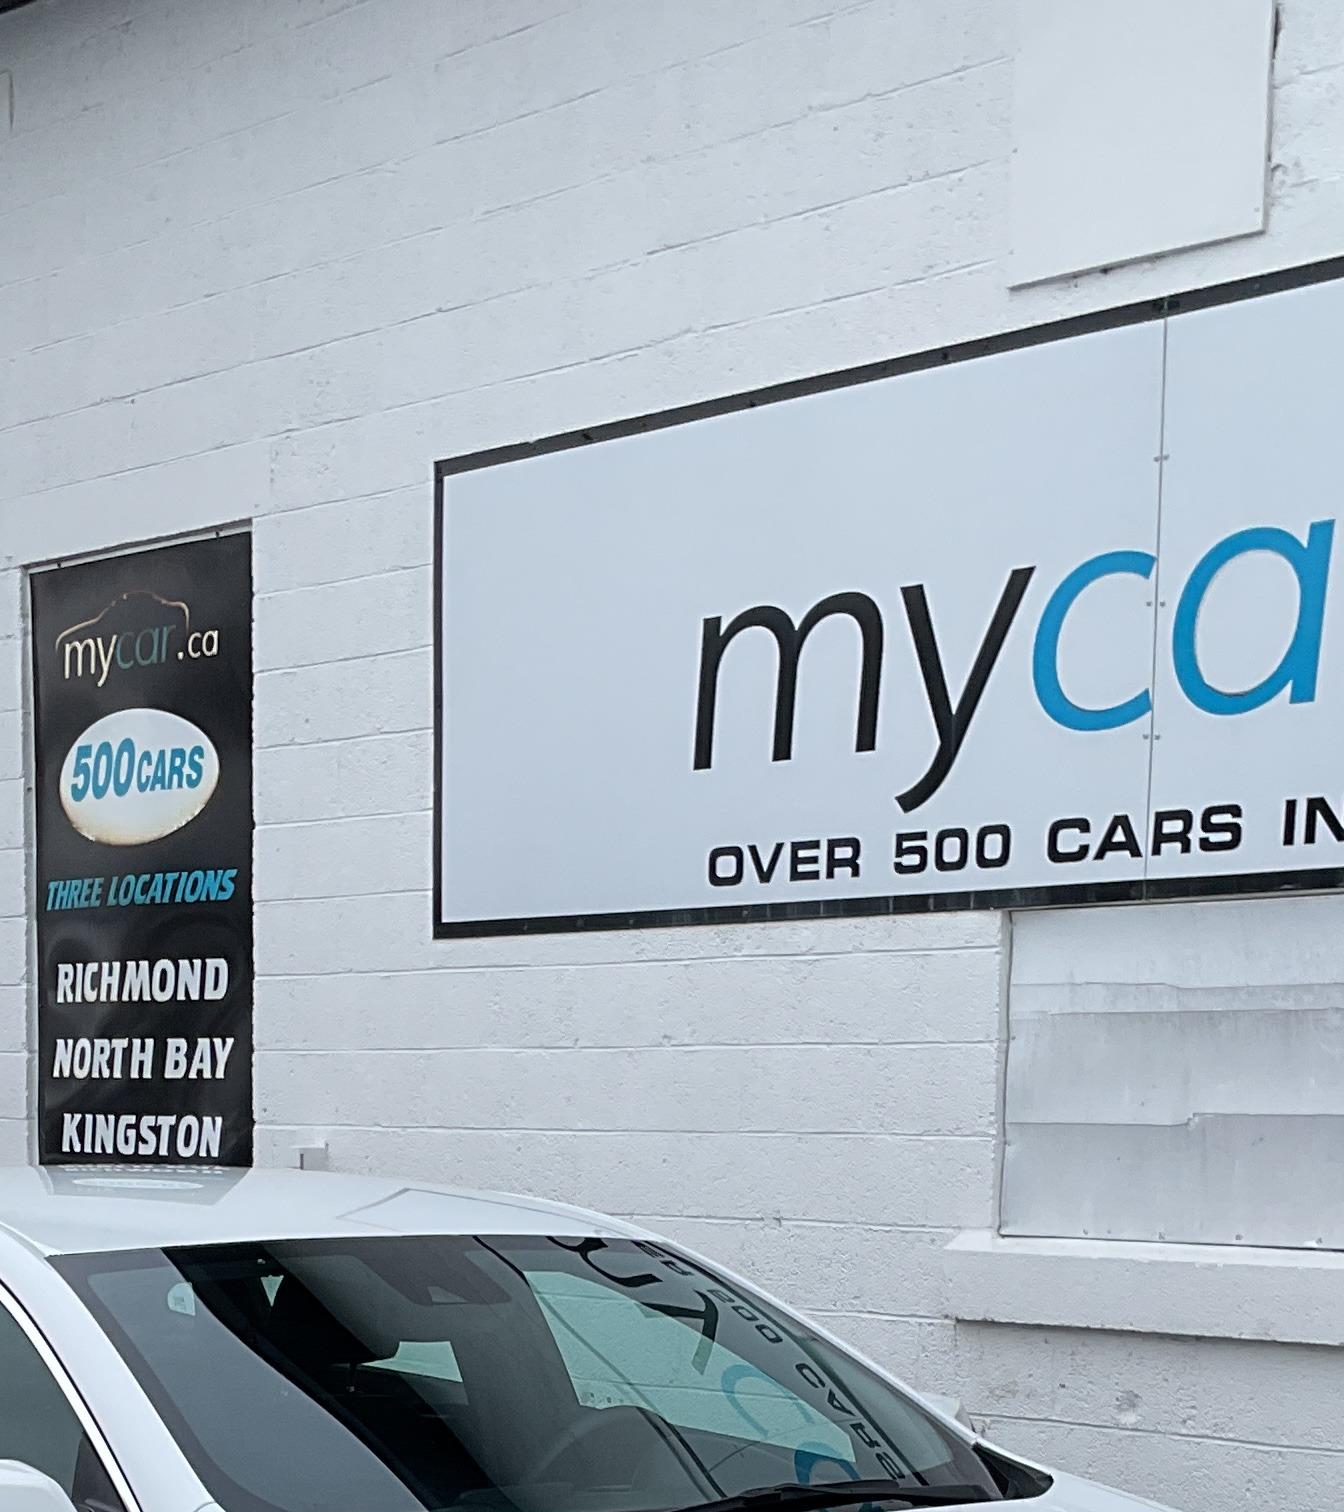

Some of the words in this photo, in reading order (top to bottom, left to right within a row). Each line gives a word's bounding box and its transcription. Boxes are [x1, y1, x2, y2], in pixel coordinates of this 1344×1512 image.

[64, 624, 219, 688] mycar.ca
[708, 837, 861, 887] OVER
[893, 823, 1011, 866] 500
[1047, 803, 1243, 864] CARS
[46, 876, 105, 911] THREE
[106, 868, 238, 907] LOCATIONS
[56, 957, 229, 1003] RICHMOND
[52, 1037, 155, 1079] NORTH
[163, 1037, 236, 1079] BAY
[61, 1112, 224, 1158] KINGSTON
